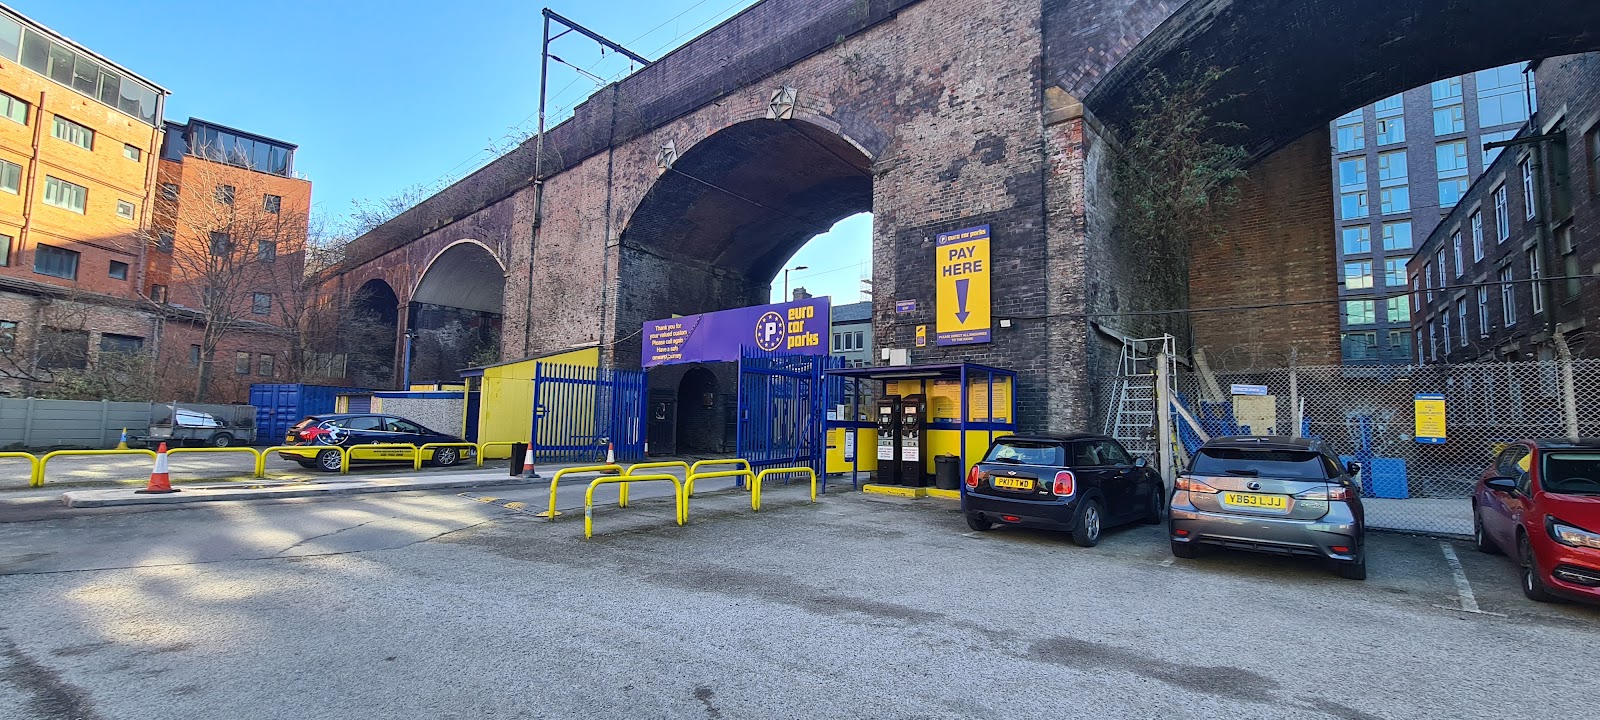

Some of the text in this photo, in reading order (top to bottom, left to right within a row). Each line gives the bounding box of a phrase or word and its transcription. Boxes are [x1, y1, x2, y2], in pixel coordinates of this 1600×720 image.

[949, 245, 976, 261] PAY
[942, 260, 982, 277] HERE
[788, 305, 814, 320] euro
[765, 322, 776, 342] P
[787, 320, 805, 333] car
[787, 331, 819, 350] parks
[998, 478, 1029, 487] PK17 TWD
[1229, 494, 1281, 506] YB63 LJJ
